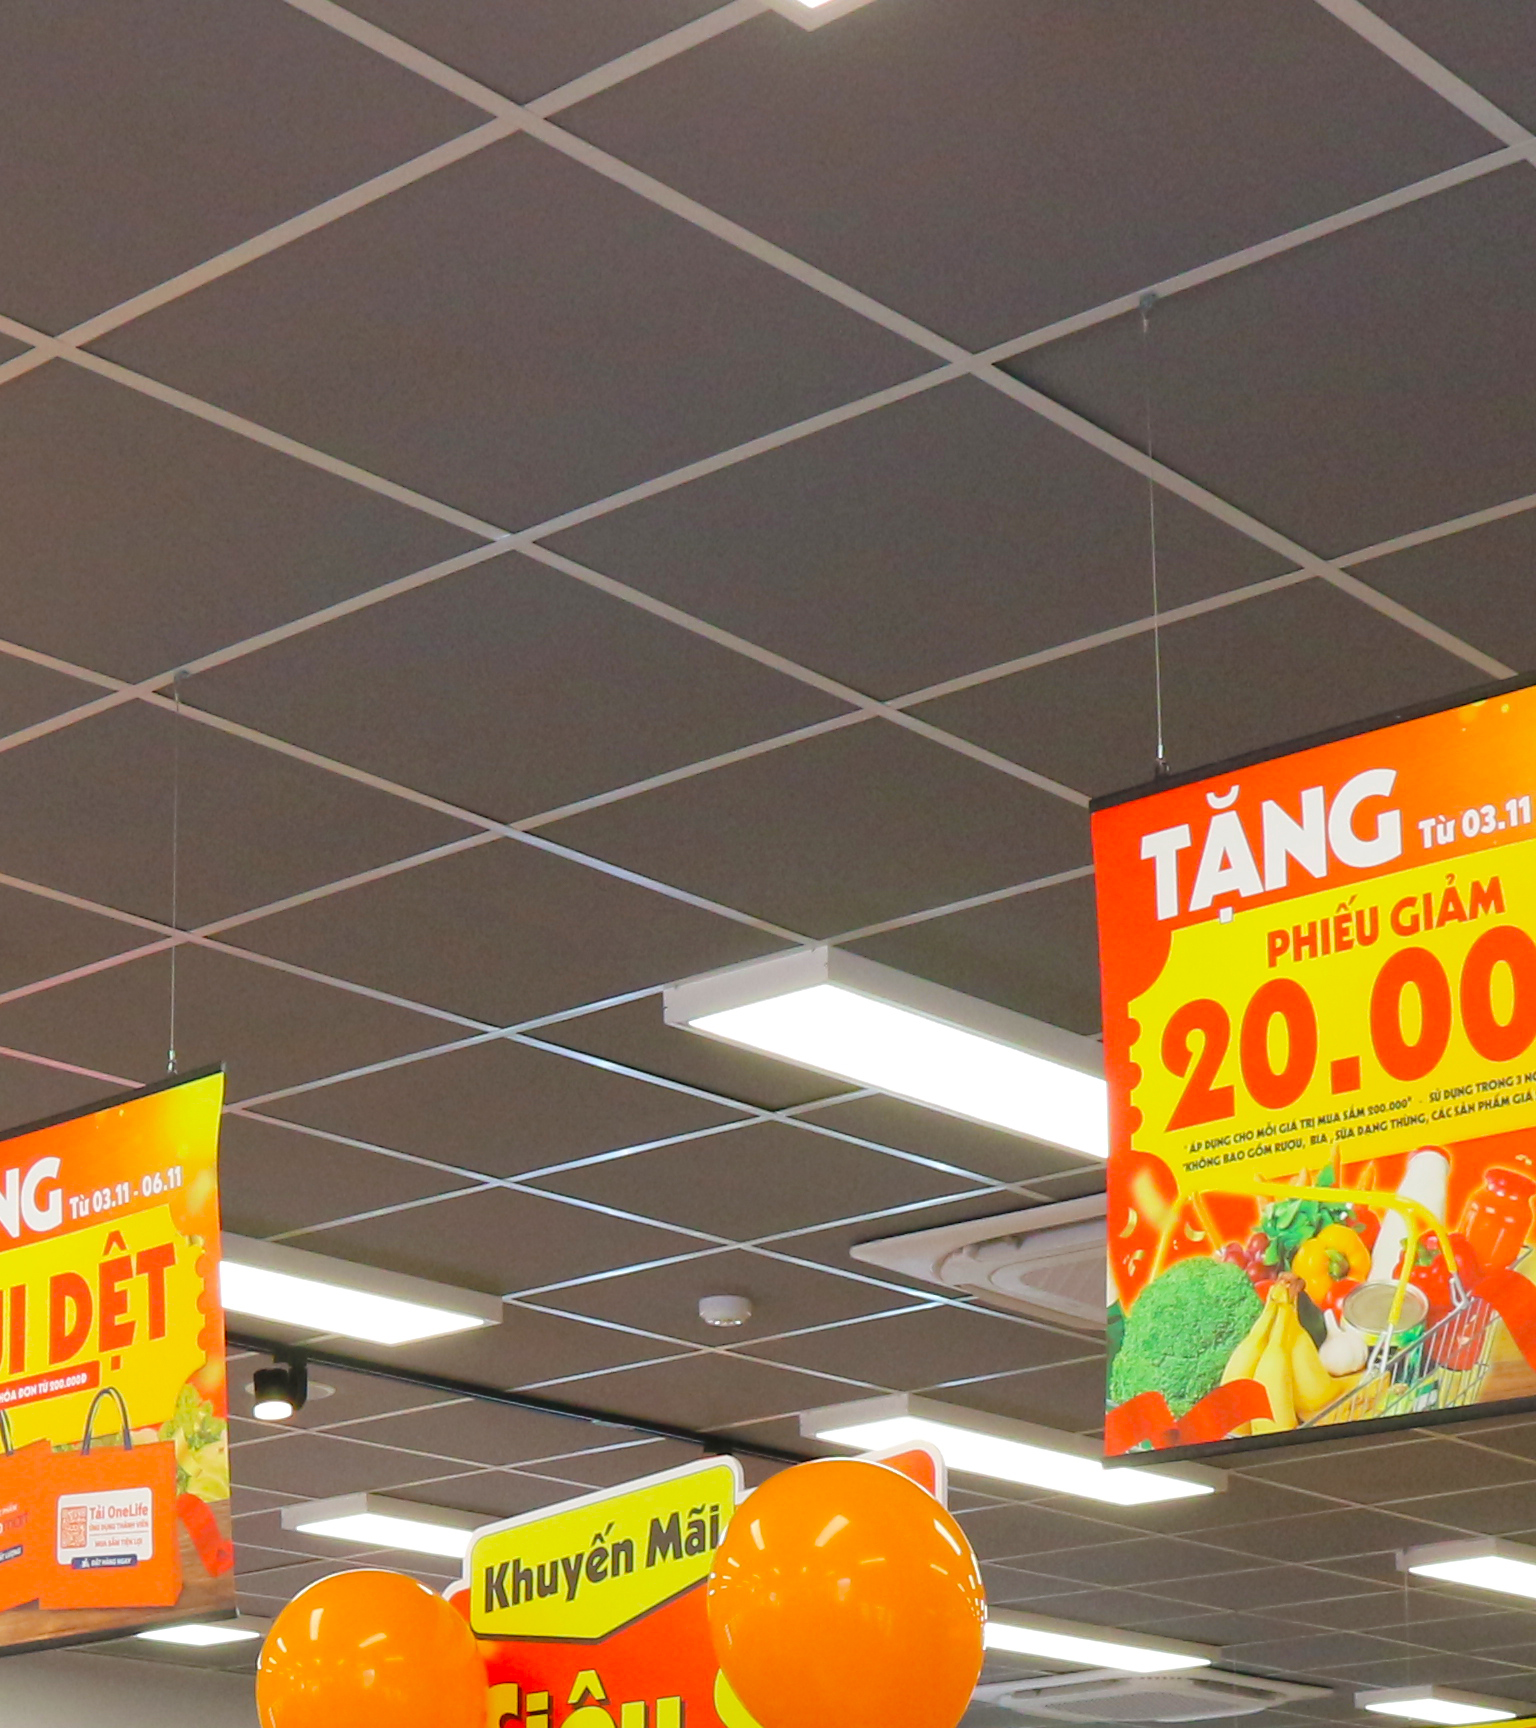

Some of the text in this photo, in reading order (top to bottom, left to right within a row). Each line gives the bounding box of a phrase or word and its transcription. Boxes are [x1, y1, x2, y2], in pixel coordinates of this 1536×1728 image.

[1141, 768, 1401, 924] TẶNG
[1418, 819, 1454, 849] Từ
[1461, 795, 1530, 838] 03.11
[1267, 873, 1505, 967] PHIẾU GIẢM
[1189, 1143, 1202, 1153] ÁP
[1205, 1136, 1231, 1151] DỤNG
[1233, 1131, 1254, 1142] CHO
[1279, 1120, 1297, 1133] GIÁ
[1318, 1113, 1340, 1125] MUA
[1444, 1085, 1472, 1099] DỤNG
[1476, 1076, 1513, 1093] TRONG
[1516, 1075, 1522, 1084] 3
[69, 1198, 89, 1219] Từ
[93, 1182, 130, 1212] 03.11
[142, 1166, 182, 1198] 06.11
[49, 1230, 176, 1371] DỆT
[89, 1502, 149, 1519] Tải OneLife
[484, 1505, 721, 1613] Khuyến Mãi
